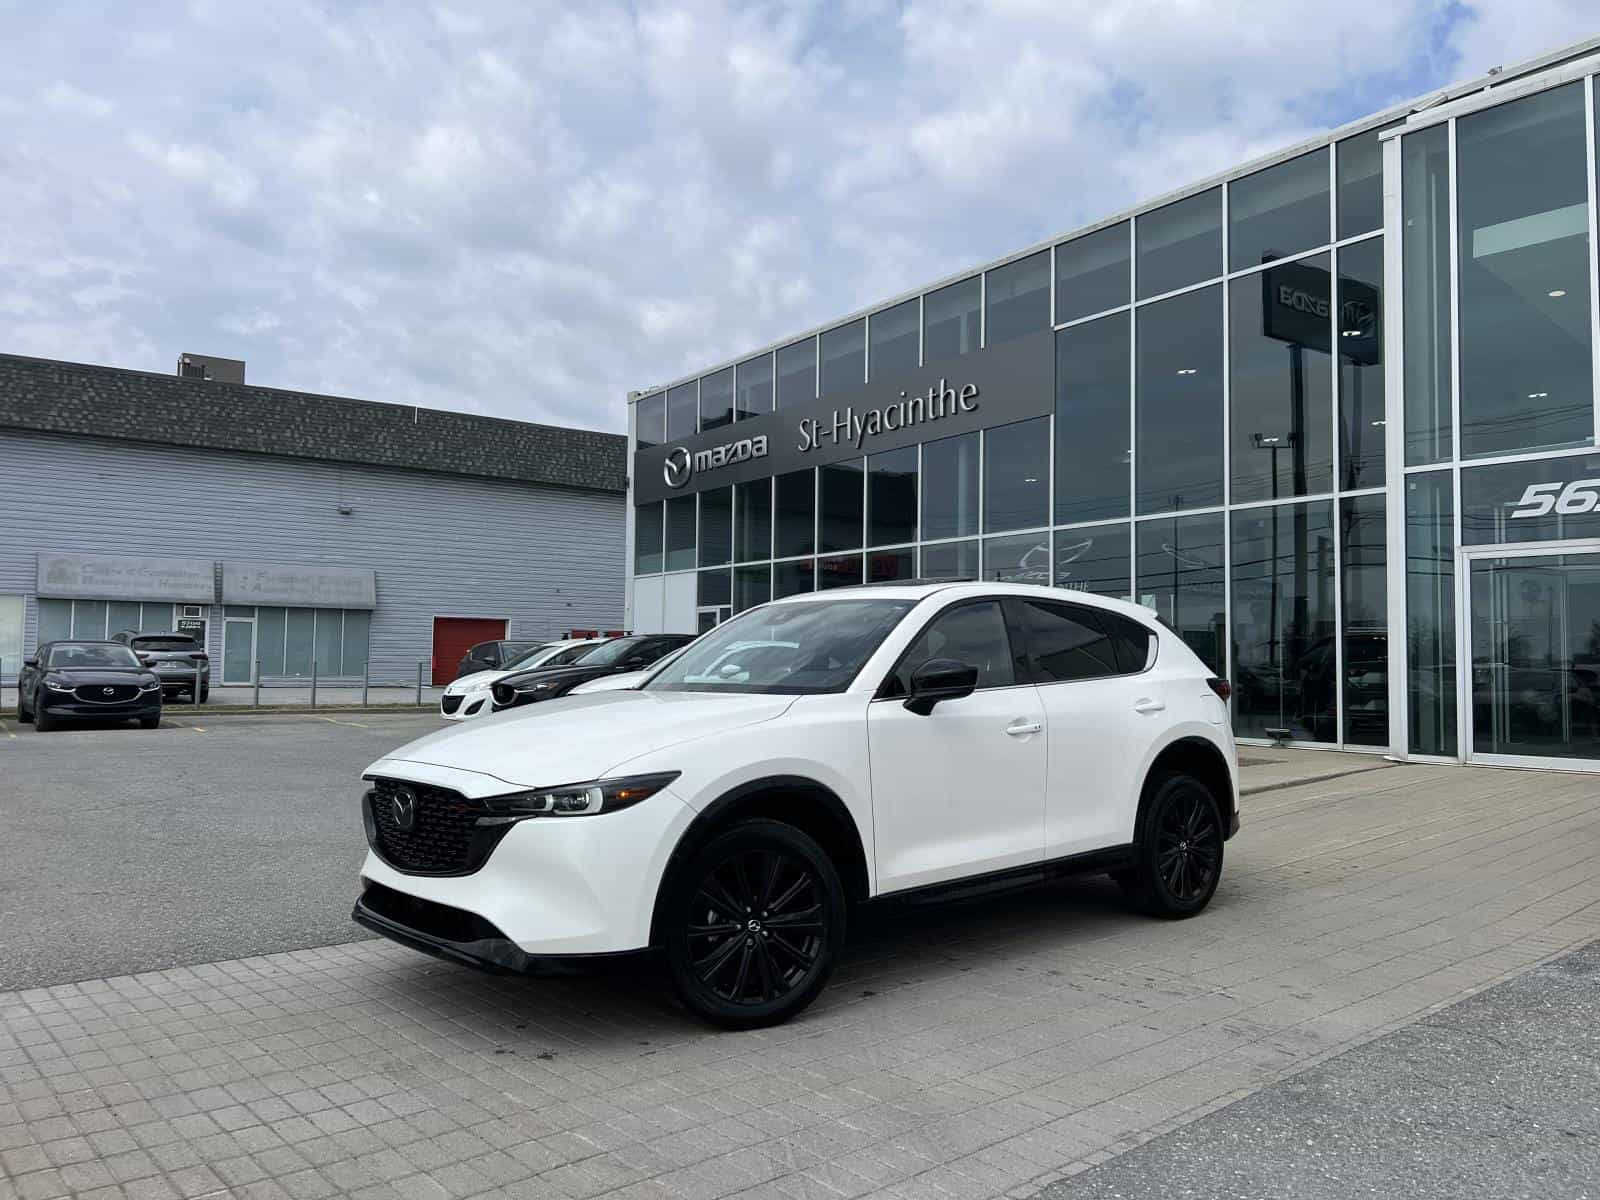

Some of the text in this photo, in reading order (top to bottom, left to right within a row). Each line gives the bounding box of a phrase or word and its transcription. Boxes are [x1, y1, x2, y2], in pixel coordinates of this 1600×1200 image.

[695, 378, 979, 472] mazda St-Hyacinthe
[1510, 479, 1600, 519] 56
